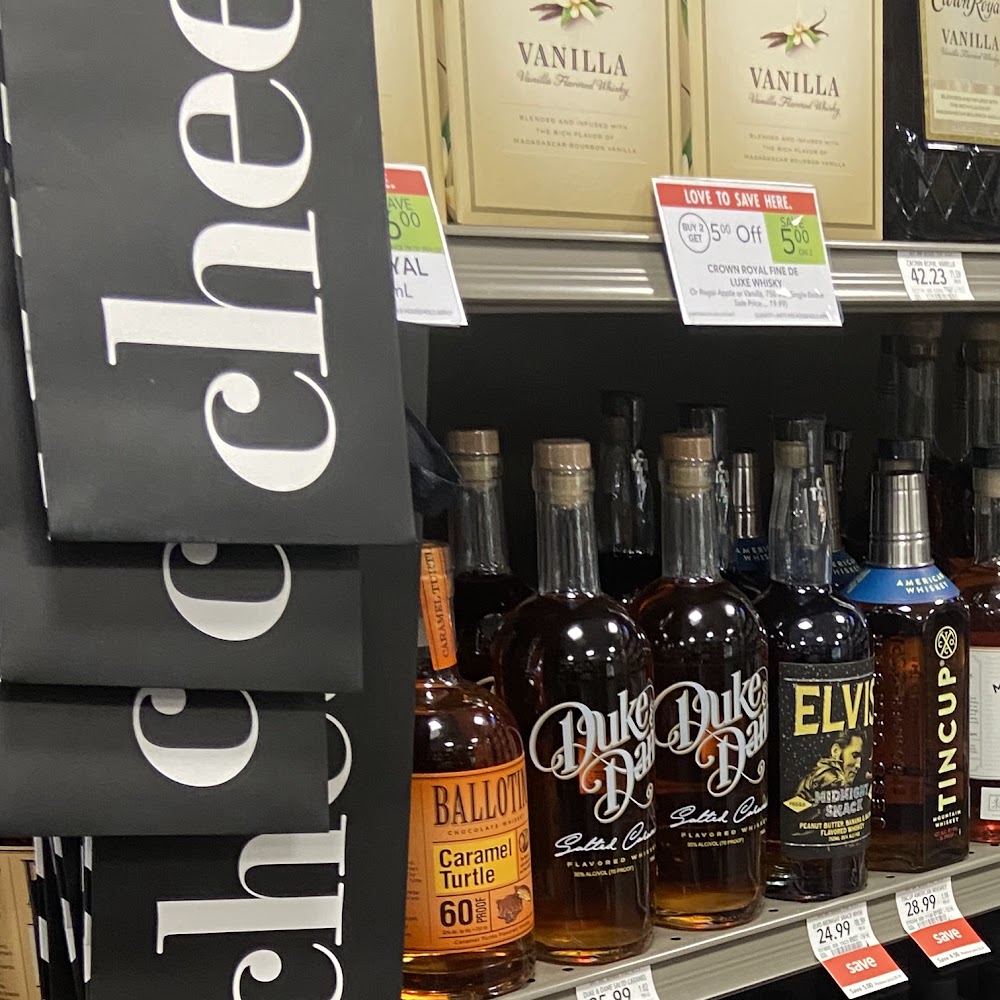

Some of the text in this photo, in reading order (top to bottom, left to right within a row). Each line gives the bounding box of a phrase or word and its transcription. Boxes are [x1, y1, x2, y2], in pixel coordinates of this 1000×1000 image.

[941, 28, 999, 51] VANILLA
[517, 41, 628, 77] VANILLA
[517, 70, 552, 87] Vanilla
[749, 67, 840, 98] VANILLA
[684, 189, 793, 210] LOVE TO SAVE HERE.
[682, 222, 697, 232] BUY
[688, 233, 703, 243] GET
[736, 225, 762, 244] Off
[707, 264, 799, 276] CROWN ROYAL FINE DE
[910, 267, 948, 287] 42.23
[730, 278, 783, 288] LUXE WHISKY
[435, 596, 451, 659] CARAMEL
[652, 667, 768, 754] Duke
[794, 677, 875, 737] ELVIS
[529, 688, 655, 780] Duke
[937, 666, 958, 812] TINCUP
[669, 805, 729, 828] Salted
[824, 803, 863, 819] SNACK
[554, 831, 617, 858] Salted
[681, 828, 737, 838] FLAVORED
[439, 838, 512, 870] Caramel
[566, 857, 627, 868] FLAVORED
[439, 868, 496, 891] Turtle
[439, 896, 488, 928] 60 PROOF
[905, 894, 937, 918] 28.99
[816, 920, 852, 945] 24.99
[932, 927, 963, 945] save
[845, 956, 878, 975] save
